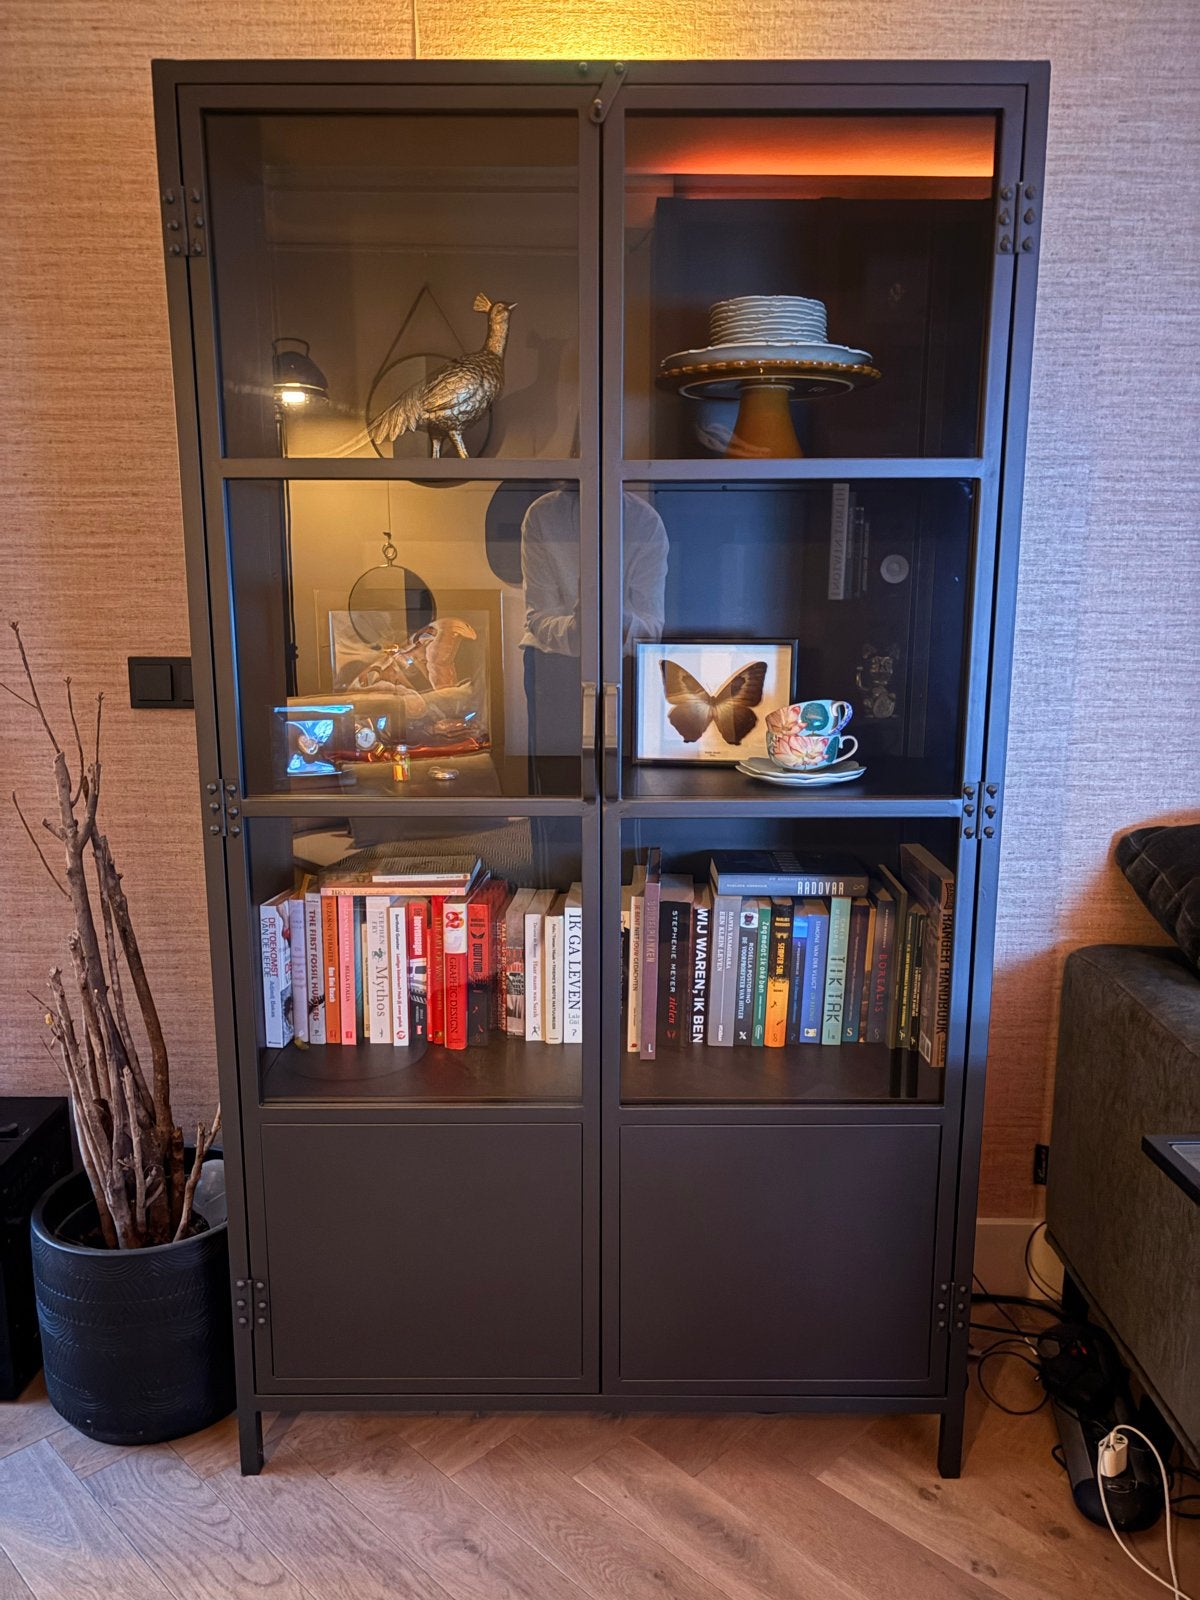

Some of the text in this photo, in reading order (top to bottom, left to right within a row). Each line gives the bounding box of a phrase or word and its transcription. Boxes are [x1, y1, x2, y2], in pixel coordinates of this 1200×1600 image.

[797, 881, 844, 895] RADOVAR
[309, 910, 317, 927] THE
[378, 911, 386, 945] STEPHEN
[697, 908, 709, 934] WIJ
[760, 921, 769, 933] Zeg
[814, 920, 822, 944] SIMONE
[261, 918, 272, 978] VAN DE LIEFDE
[269, 917, 279, 978] DE TOEKOMST
[310, 930, 318, 952] FIRST
[940, 913, 953, 964] RANGER
[311, 954, 319, 979] FOSSIL
[532, 961, 540, 974] Haar
[568, 914, 582, 1010] IK GA LEVEN
[668, 910, 679, 1024] STEPHENIE MEYER zielen
[716, 949, 724, 972] LEVEN
[739, 947, 748, 989] VOORPROEFSTER
[745, 942, 755, 1004] ROSELLA POSTORINO
[759, 957, 767, 966] ik
[372, 966, 389, 1017] Mythos
[449, 957, 459, 1034] GRAPHIC DESIGN
[758, 979, 766, 993] ben
[825, 956, 846, 1023] TIK TAK
[874, 953, 889, 1013] BOREALIS
[693, 997, 705, 1012] IK
[736, 1000, 744, 1019] HITLER
[935, 967, 951, 1035] HANDBOOK
[692, 1015, 704, 1043] BEN
